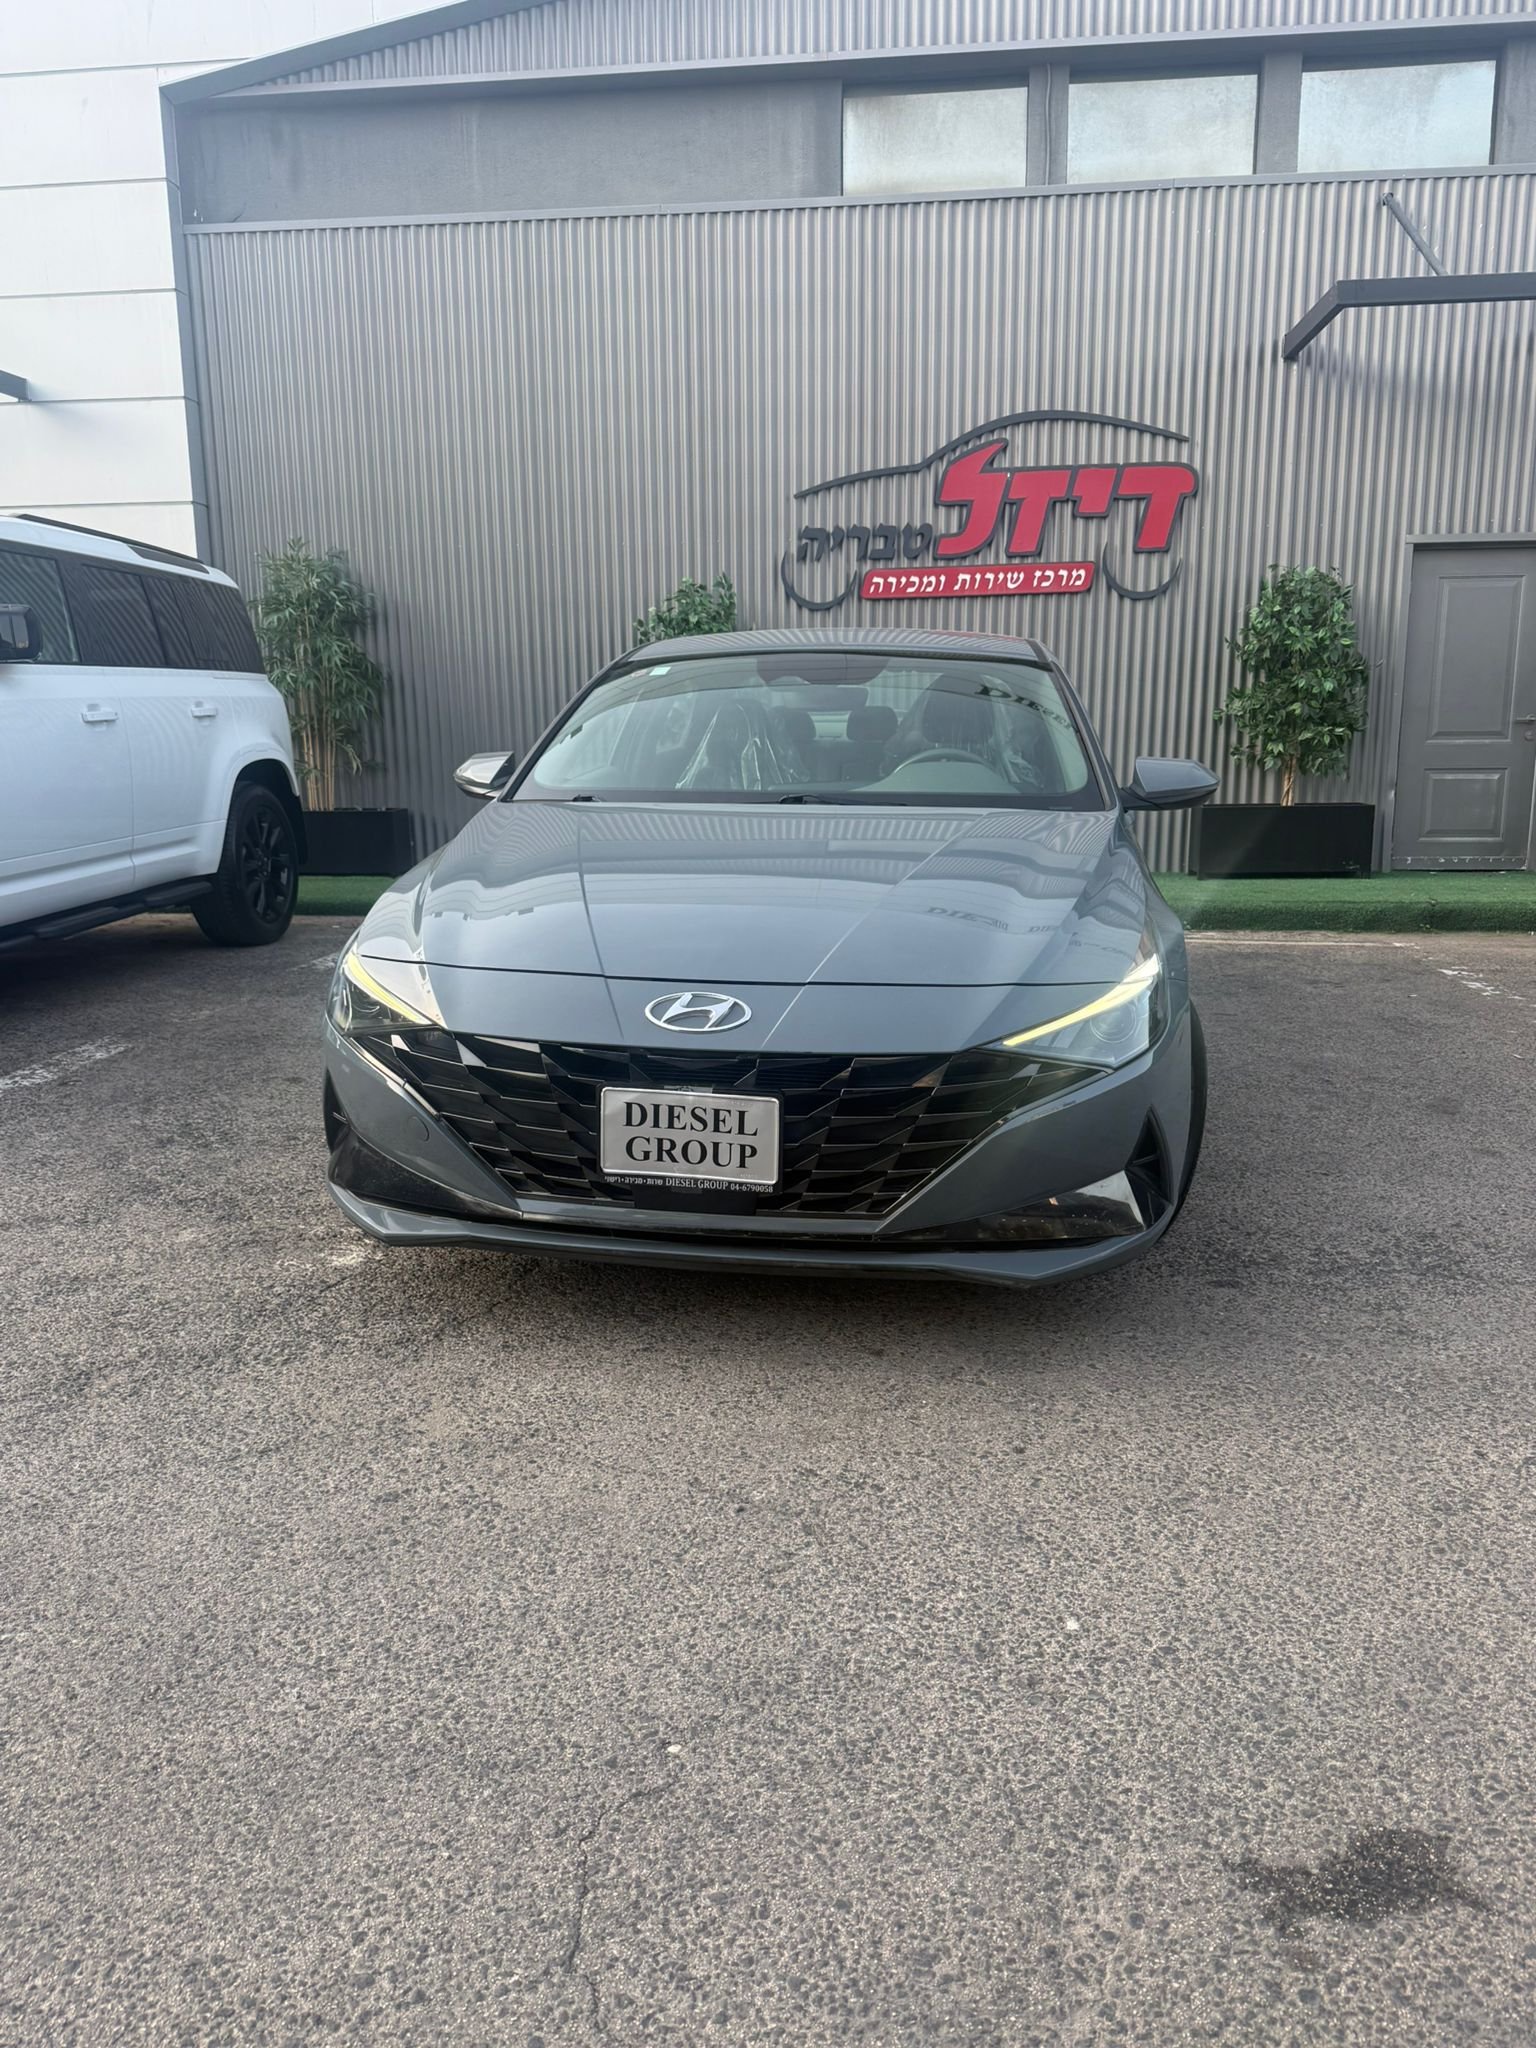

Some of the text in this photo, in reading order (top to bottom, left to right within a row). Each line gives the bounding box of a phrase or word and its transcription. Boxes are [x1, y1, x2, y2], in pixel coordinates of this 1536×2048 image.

[797, 437, 1199, 561] דיזל טבריה
[869, 566, 1086, 595] מרכז שירות ומכירה
[623, 1102, 758, 1135] DIESEL
[625, 1135, 758, 1169] GROUP
[666, 1177, 773, 1193] DIESEL GROUP 04-6790058
